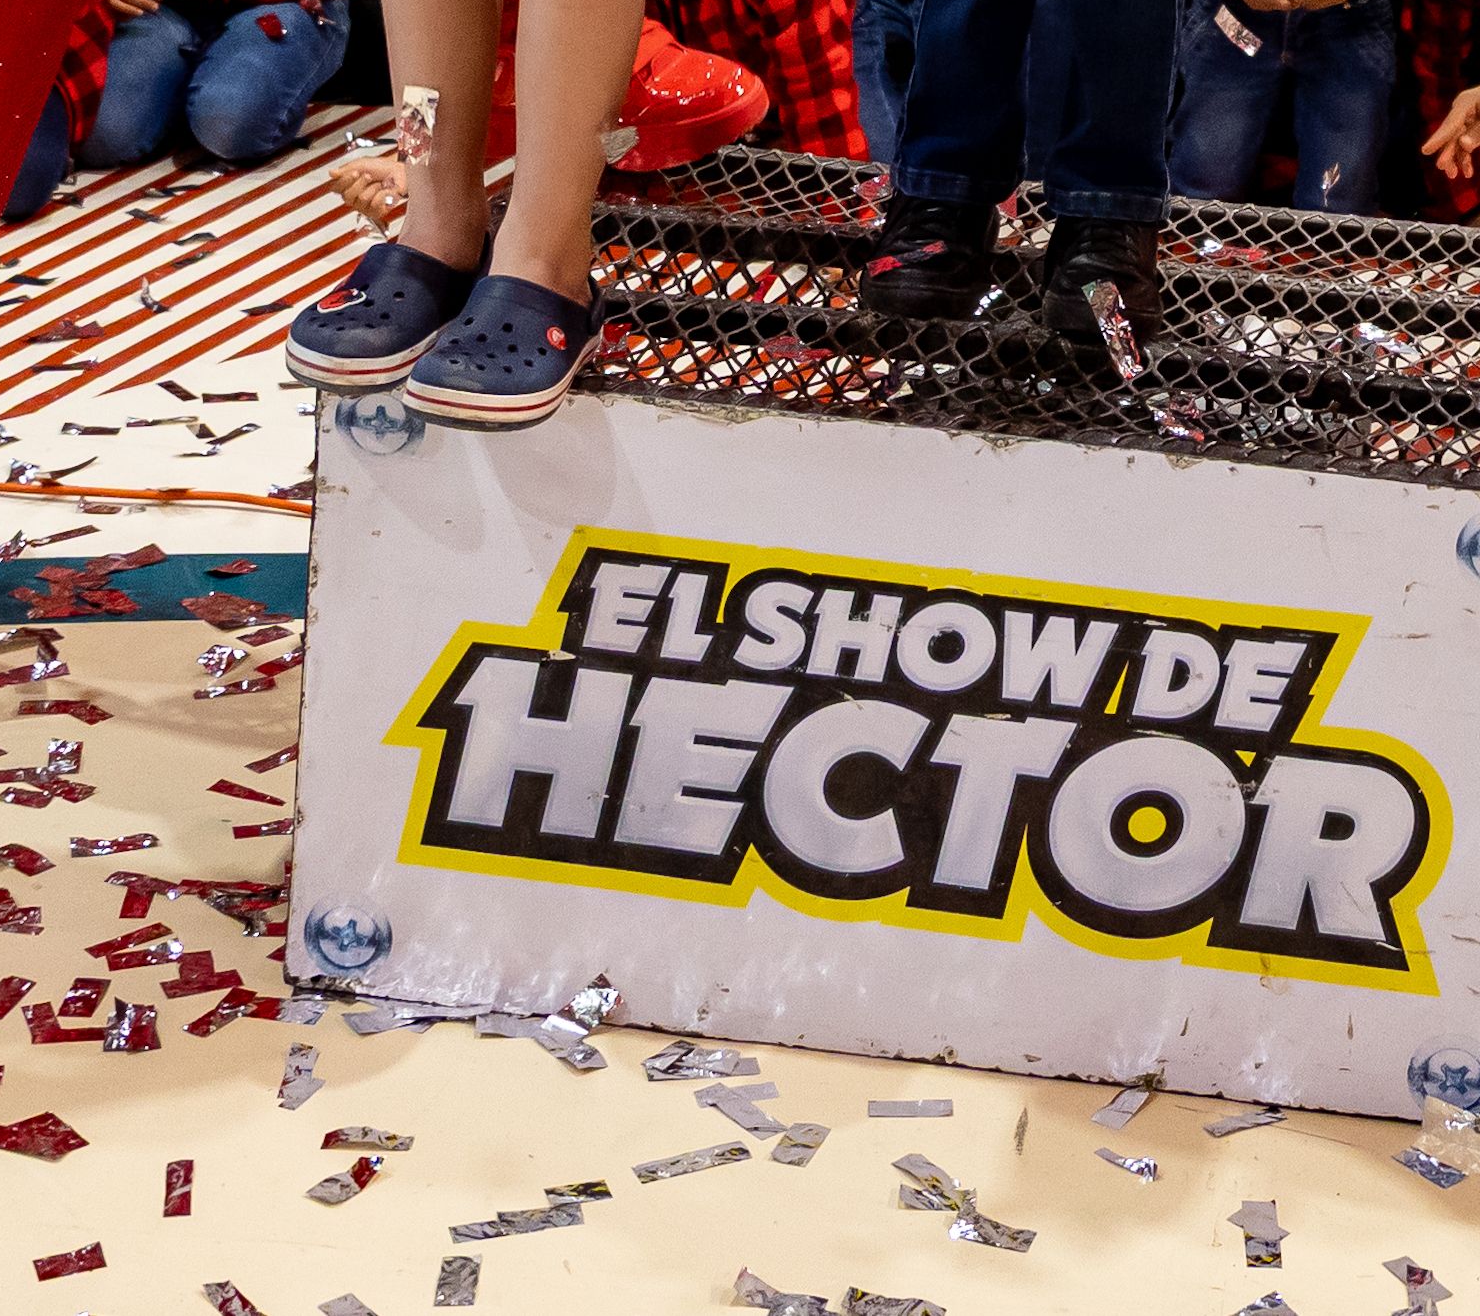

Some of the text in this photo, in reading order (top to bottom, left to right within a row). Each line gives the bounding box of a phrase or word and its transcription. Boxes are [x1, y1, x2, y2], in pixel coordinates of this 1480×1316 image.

[579, 562, 1308, 732] EL SHOW DE
[446, 656, 1416, 942] HECTOR
